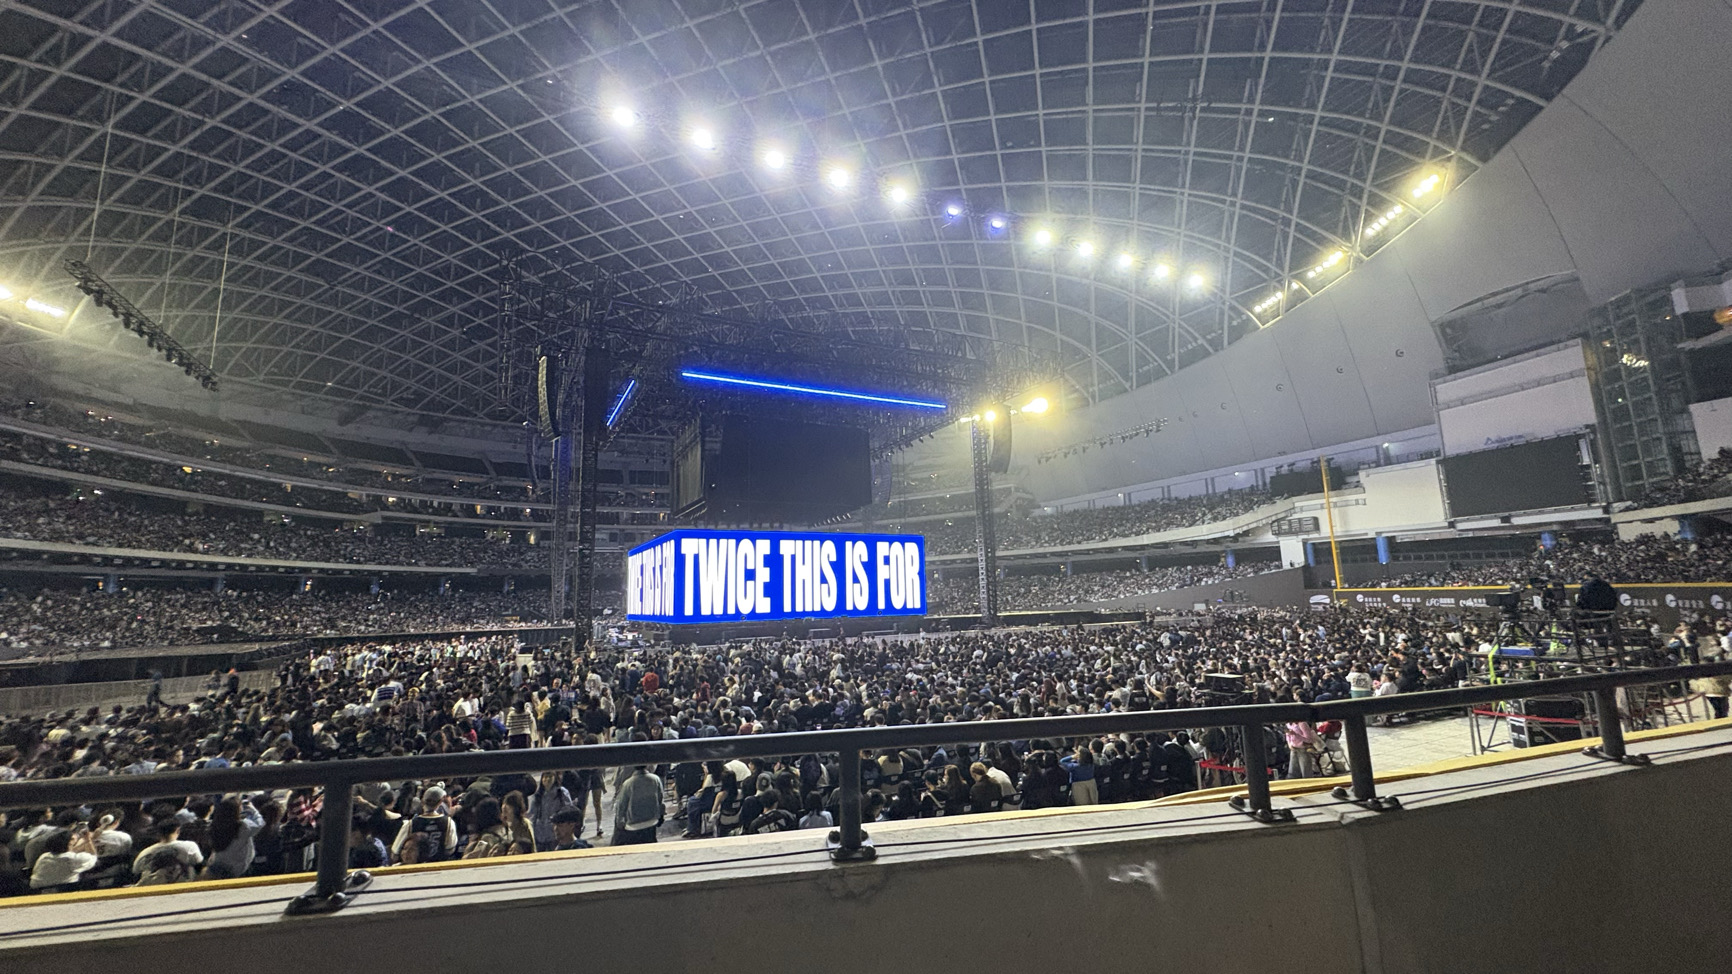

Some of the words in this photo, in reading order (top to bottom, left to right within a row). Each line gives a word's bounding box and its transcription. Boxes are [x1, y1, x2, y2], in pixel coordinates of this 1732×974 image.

[681, 538, 771, 616] TWICE
[779, 540, 837, 612] THIS
[845, 541, 868, 611] IS
[876, 541, 921, 610] FOR
